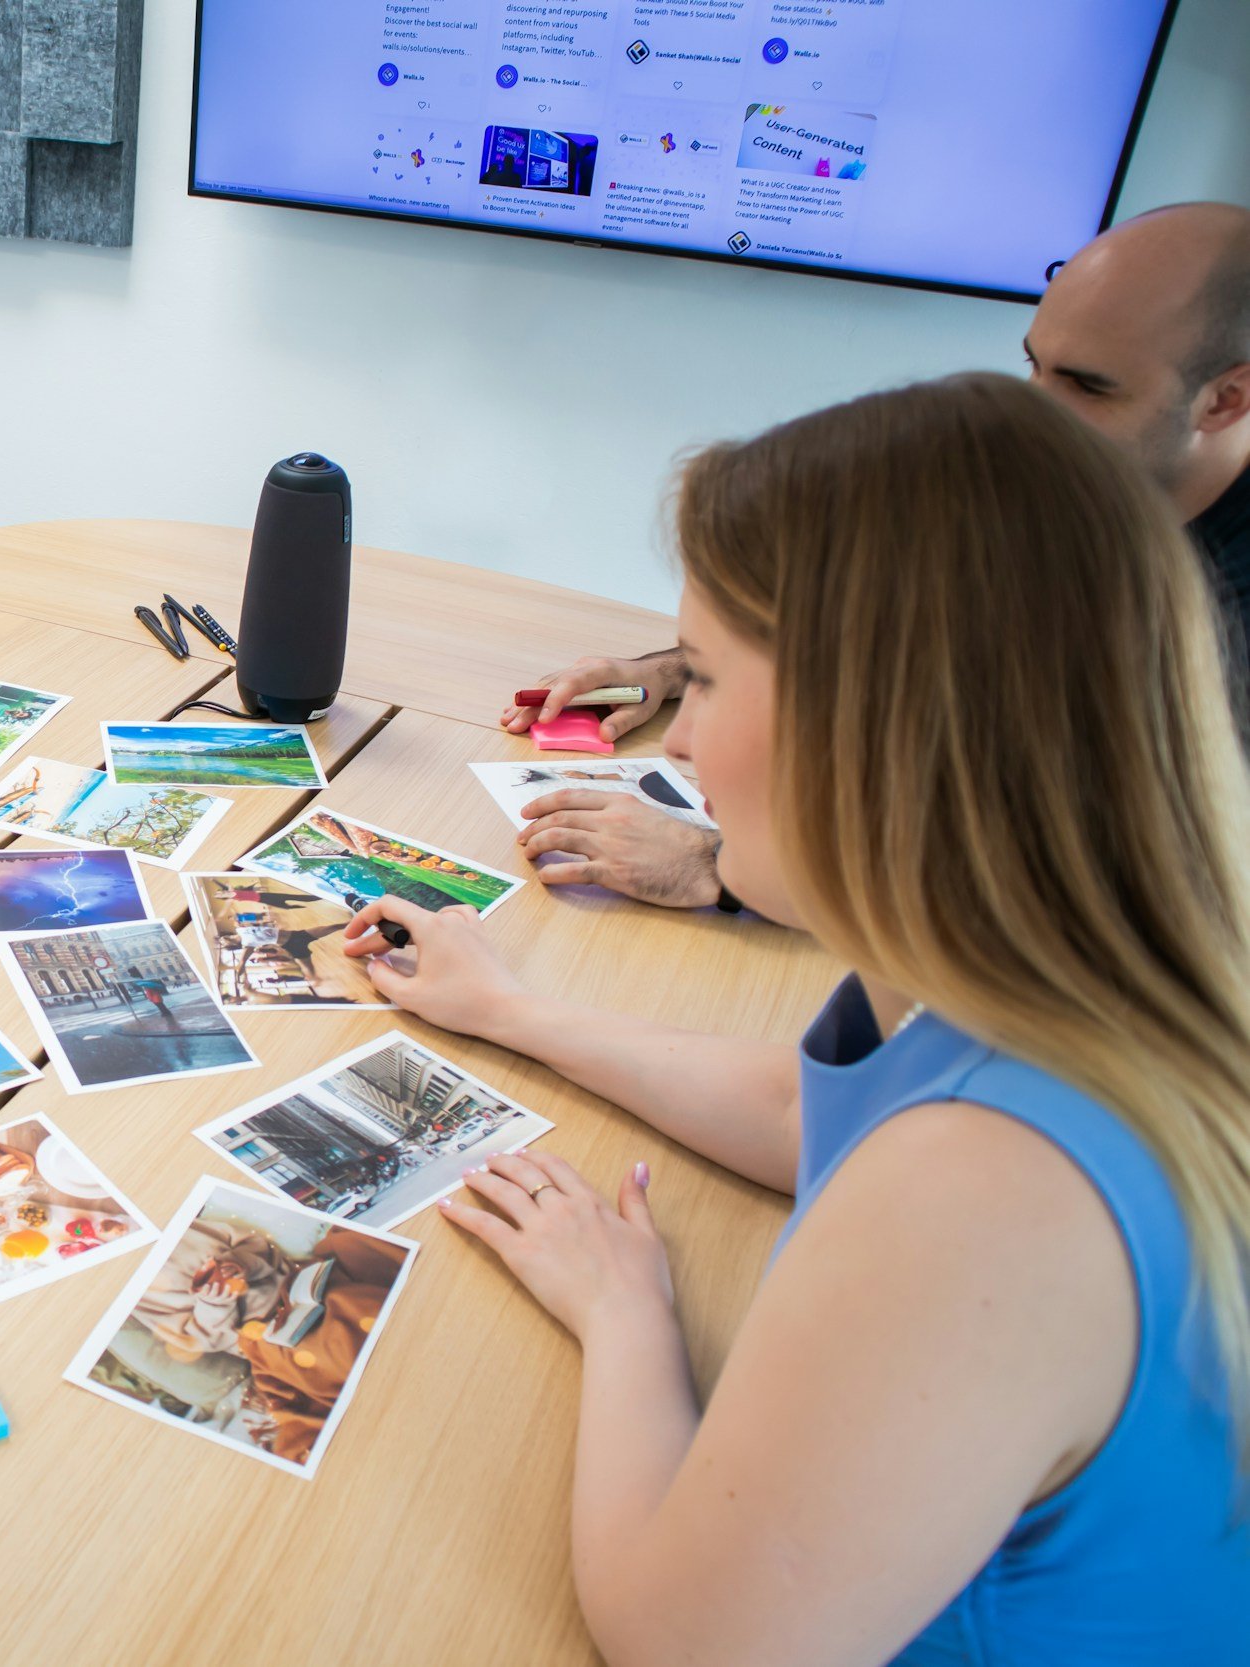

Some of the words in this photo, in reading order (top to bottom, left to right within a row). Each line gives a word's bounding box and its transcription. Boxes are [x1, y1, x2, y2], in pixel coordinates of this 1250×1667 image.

[386, 4, 429, 13] Engagement!
[506, 4, 546, 15] discovering
[564, 9, 608, 20] repurposing
[385, 17, 412, 25] Discover
[505, 18, 531, 26] content
[503, 31, 539, 40] platforms,
[541, 33, 574, 44] including
[502, 44, 538, 53] Instagram,
[541, 47, 566, 56] Twitter,
[794, 50, 820, 58] Walls.io
[498, 136, 516, 147] Good
[766, 119, 864, 155] User-Generated
[496, 145, 505, 153] be
[507, 147, 517, 155] like
[753, 136, 803, 160] Content
[617, 182, 643, 192] Breaking
[663, 188, 694, 198] @walls_io
[741, 178, 757, 186] What
[771, 181, 785, 189] UGC
[786, 183, 810, 192] Creator
[530, 199, 558, 208] Activation
[632, 196, 654, 204] partner
[740, 189, 755, 197] They
[756, 190, 788, 200] Transform
[790, 194, 822, 205] Marketing
[823, 198, 842, 206] Learn
[616, 205, 641, 213] ultimate
[642, 207, 671, 216] all-in-one
[761, 202, 786, 211] Harness
[799, 207, 820, 215] Power
[604, 214, 643, 224] management
[644, 218, 670, 227] software
[735, 211, 758, 219] Creator
[759, 213, 791, 225] Marketing
[756, 243, 780, 251] Daniela
